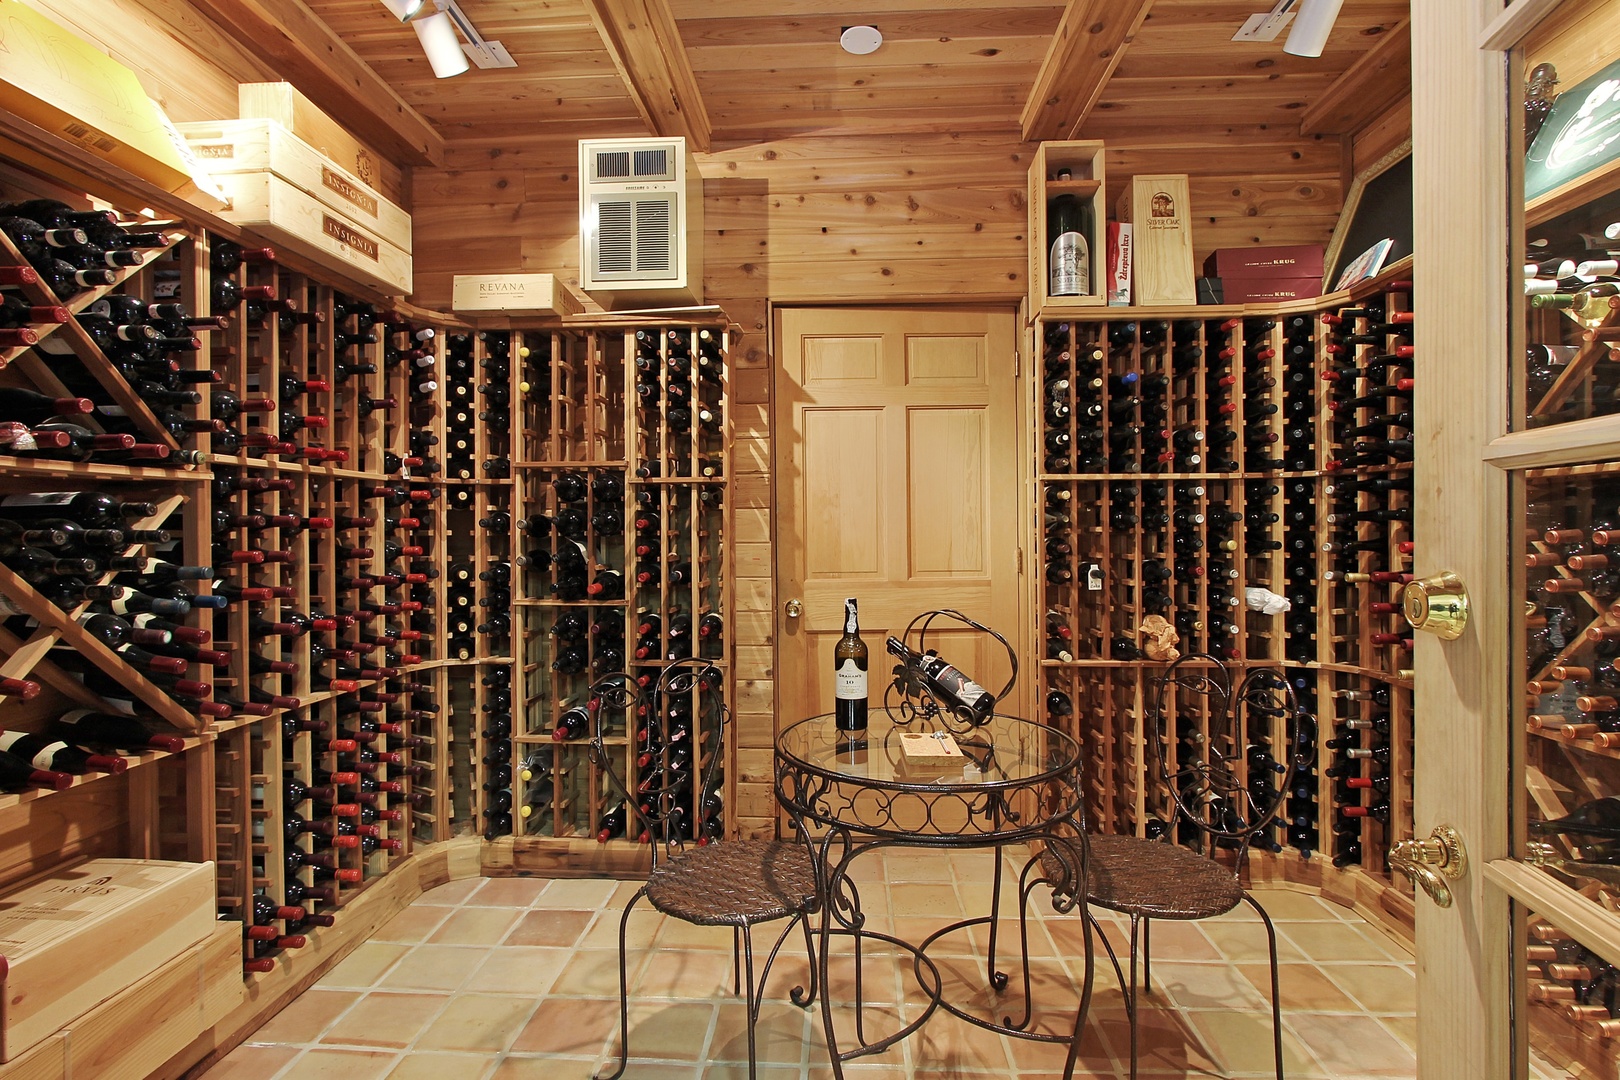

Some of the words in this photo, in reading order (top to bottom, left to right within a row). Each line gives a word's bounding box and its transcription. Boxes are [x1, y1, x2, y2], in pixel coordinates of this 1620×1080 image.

[328, 174, 373, 212] INSIGNIA
[328, 222, 374, 254] INSIGNIA
[480, 283, 525, 292] REVANA
[43, 885, 117, 895] JARVIS
